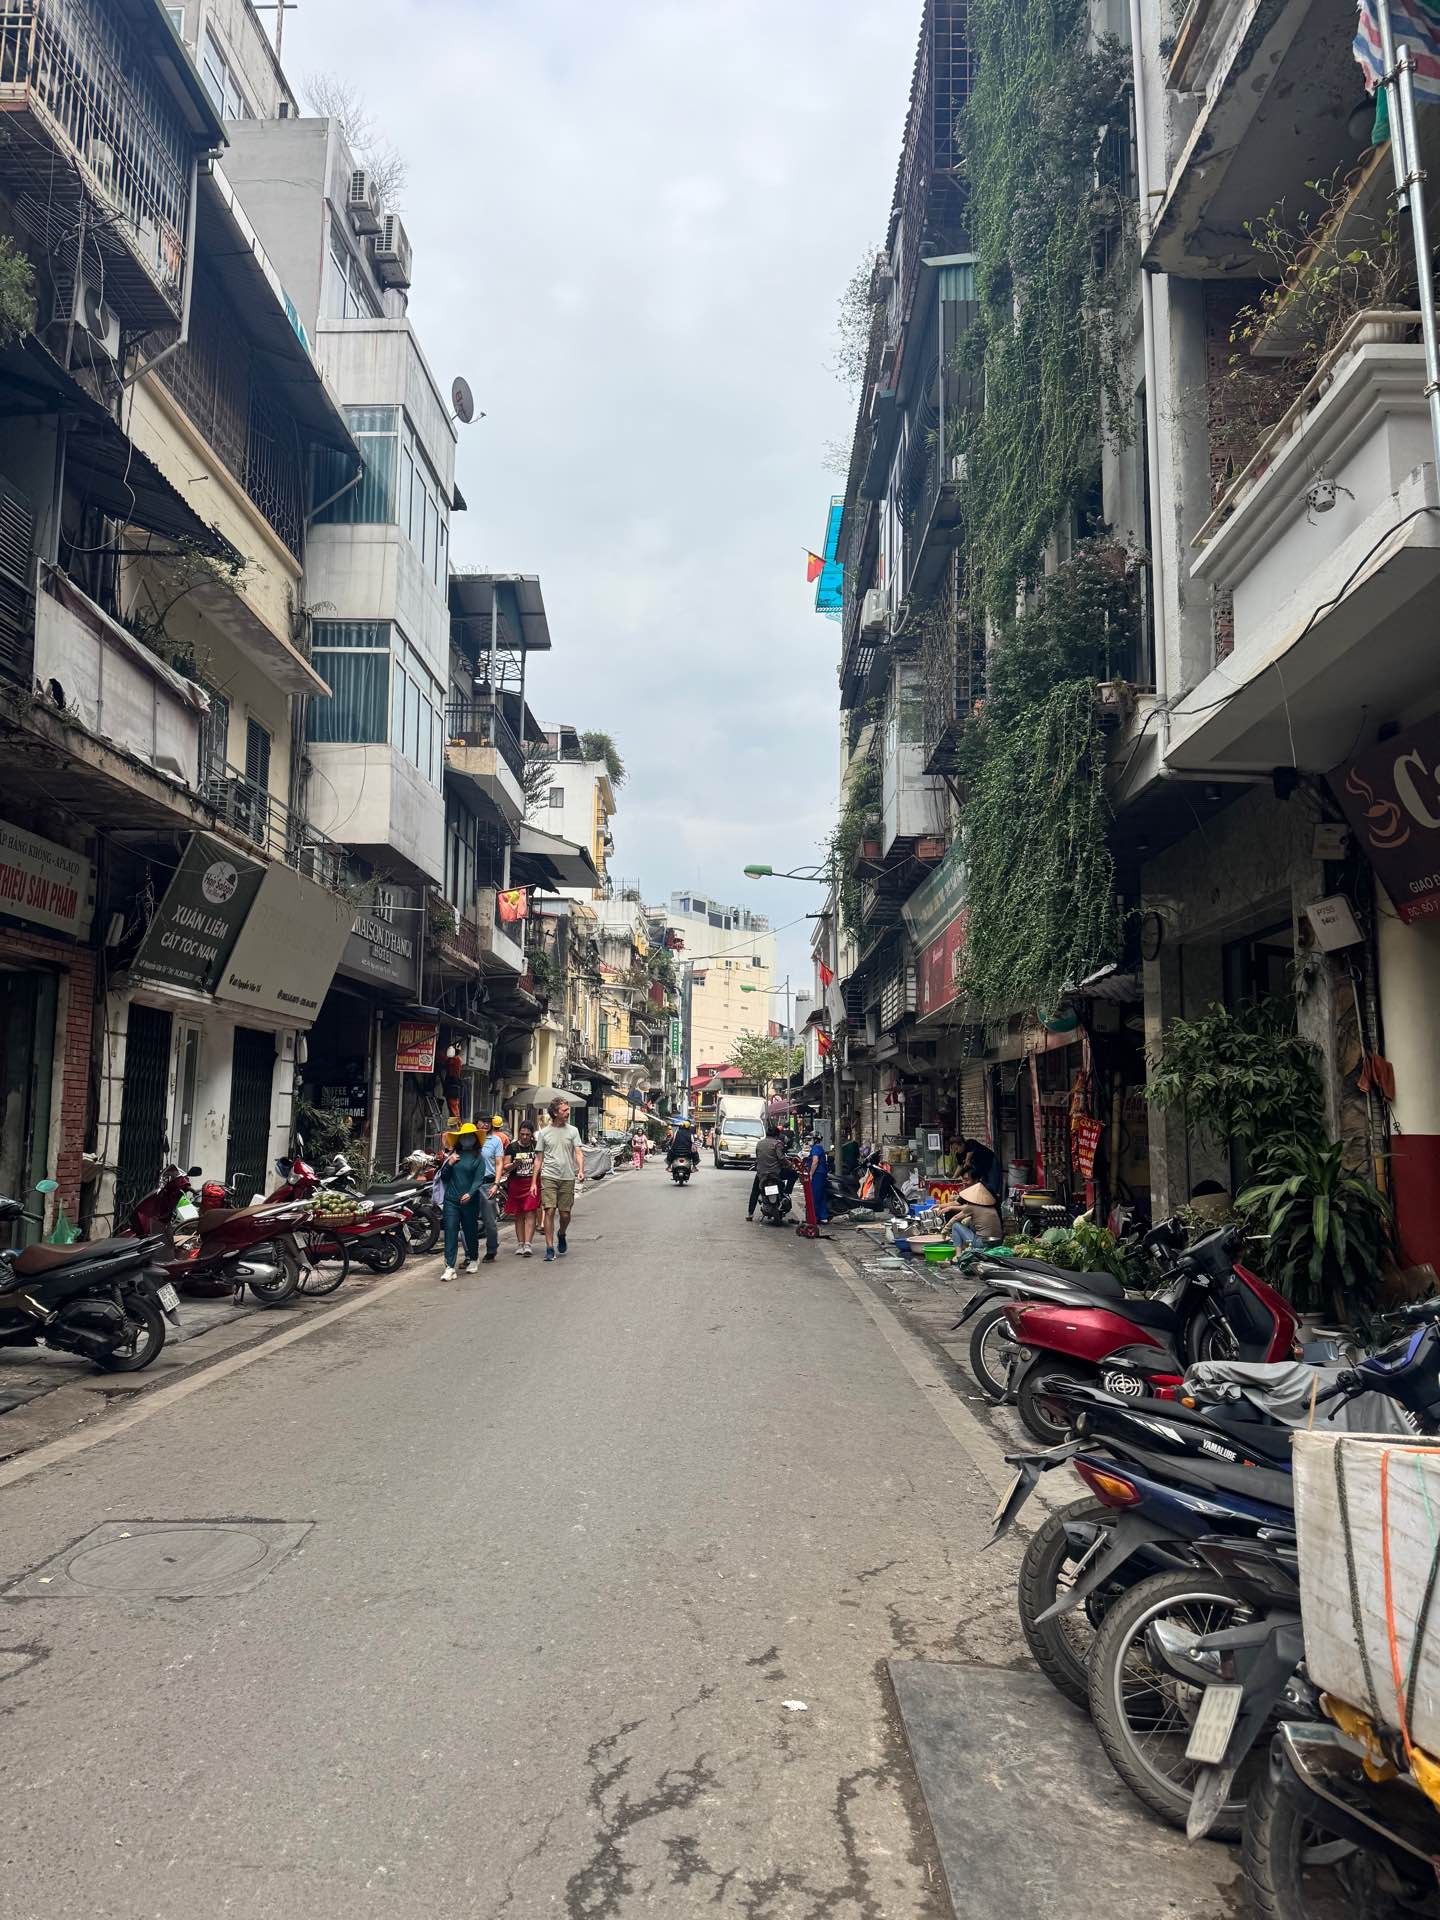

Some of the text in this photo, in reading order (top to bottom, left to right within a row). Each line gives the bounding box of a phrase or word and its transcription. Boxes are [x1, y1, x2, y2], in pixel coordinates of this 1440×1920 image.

[1393, 748, 1440, 829] C
[1408, 876, 1433, 894] GIAO
[171, 904, 229, 940] XUÂN LIÊM
[351, 916, 384, 945] MAISON
[196, 946, 218, 961] NAM
[374, 945, 392, 963] HOTEL
[1201, 1439, 1238, 1463] YAMALUBE
